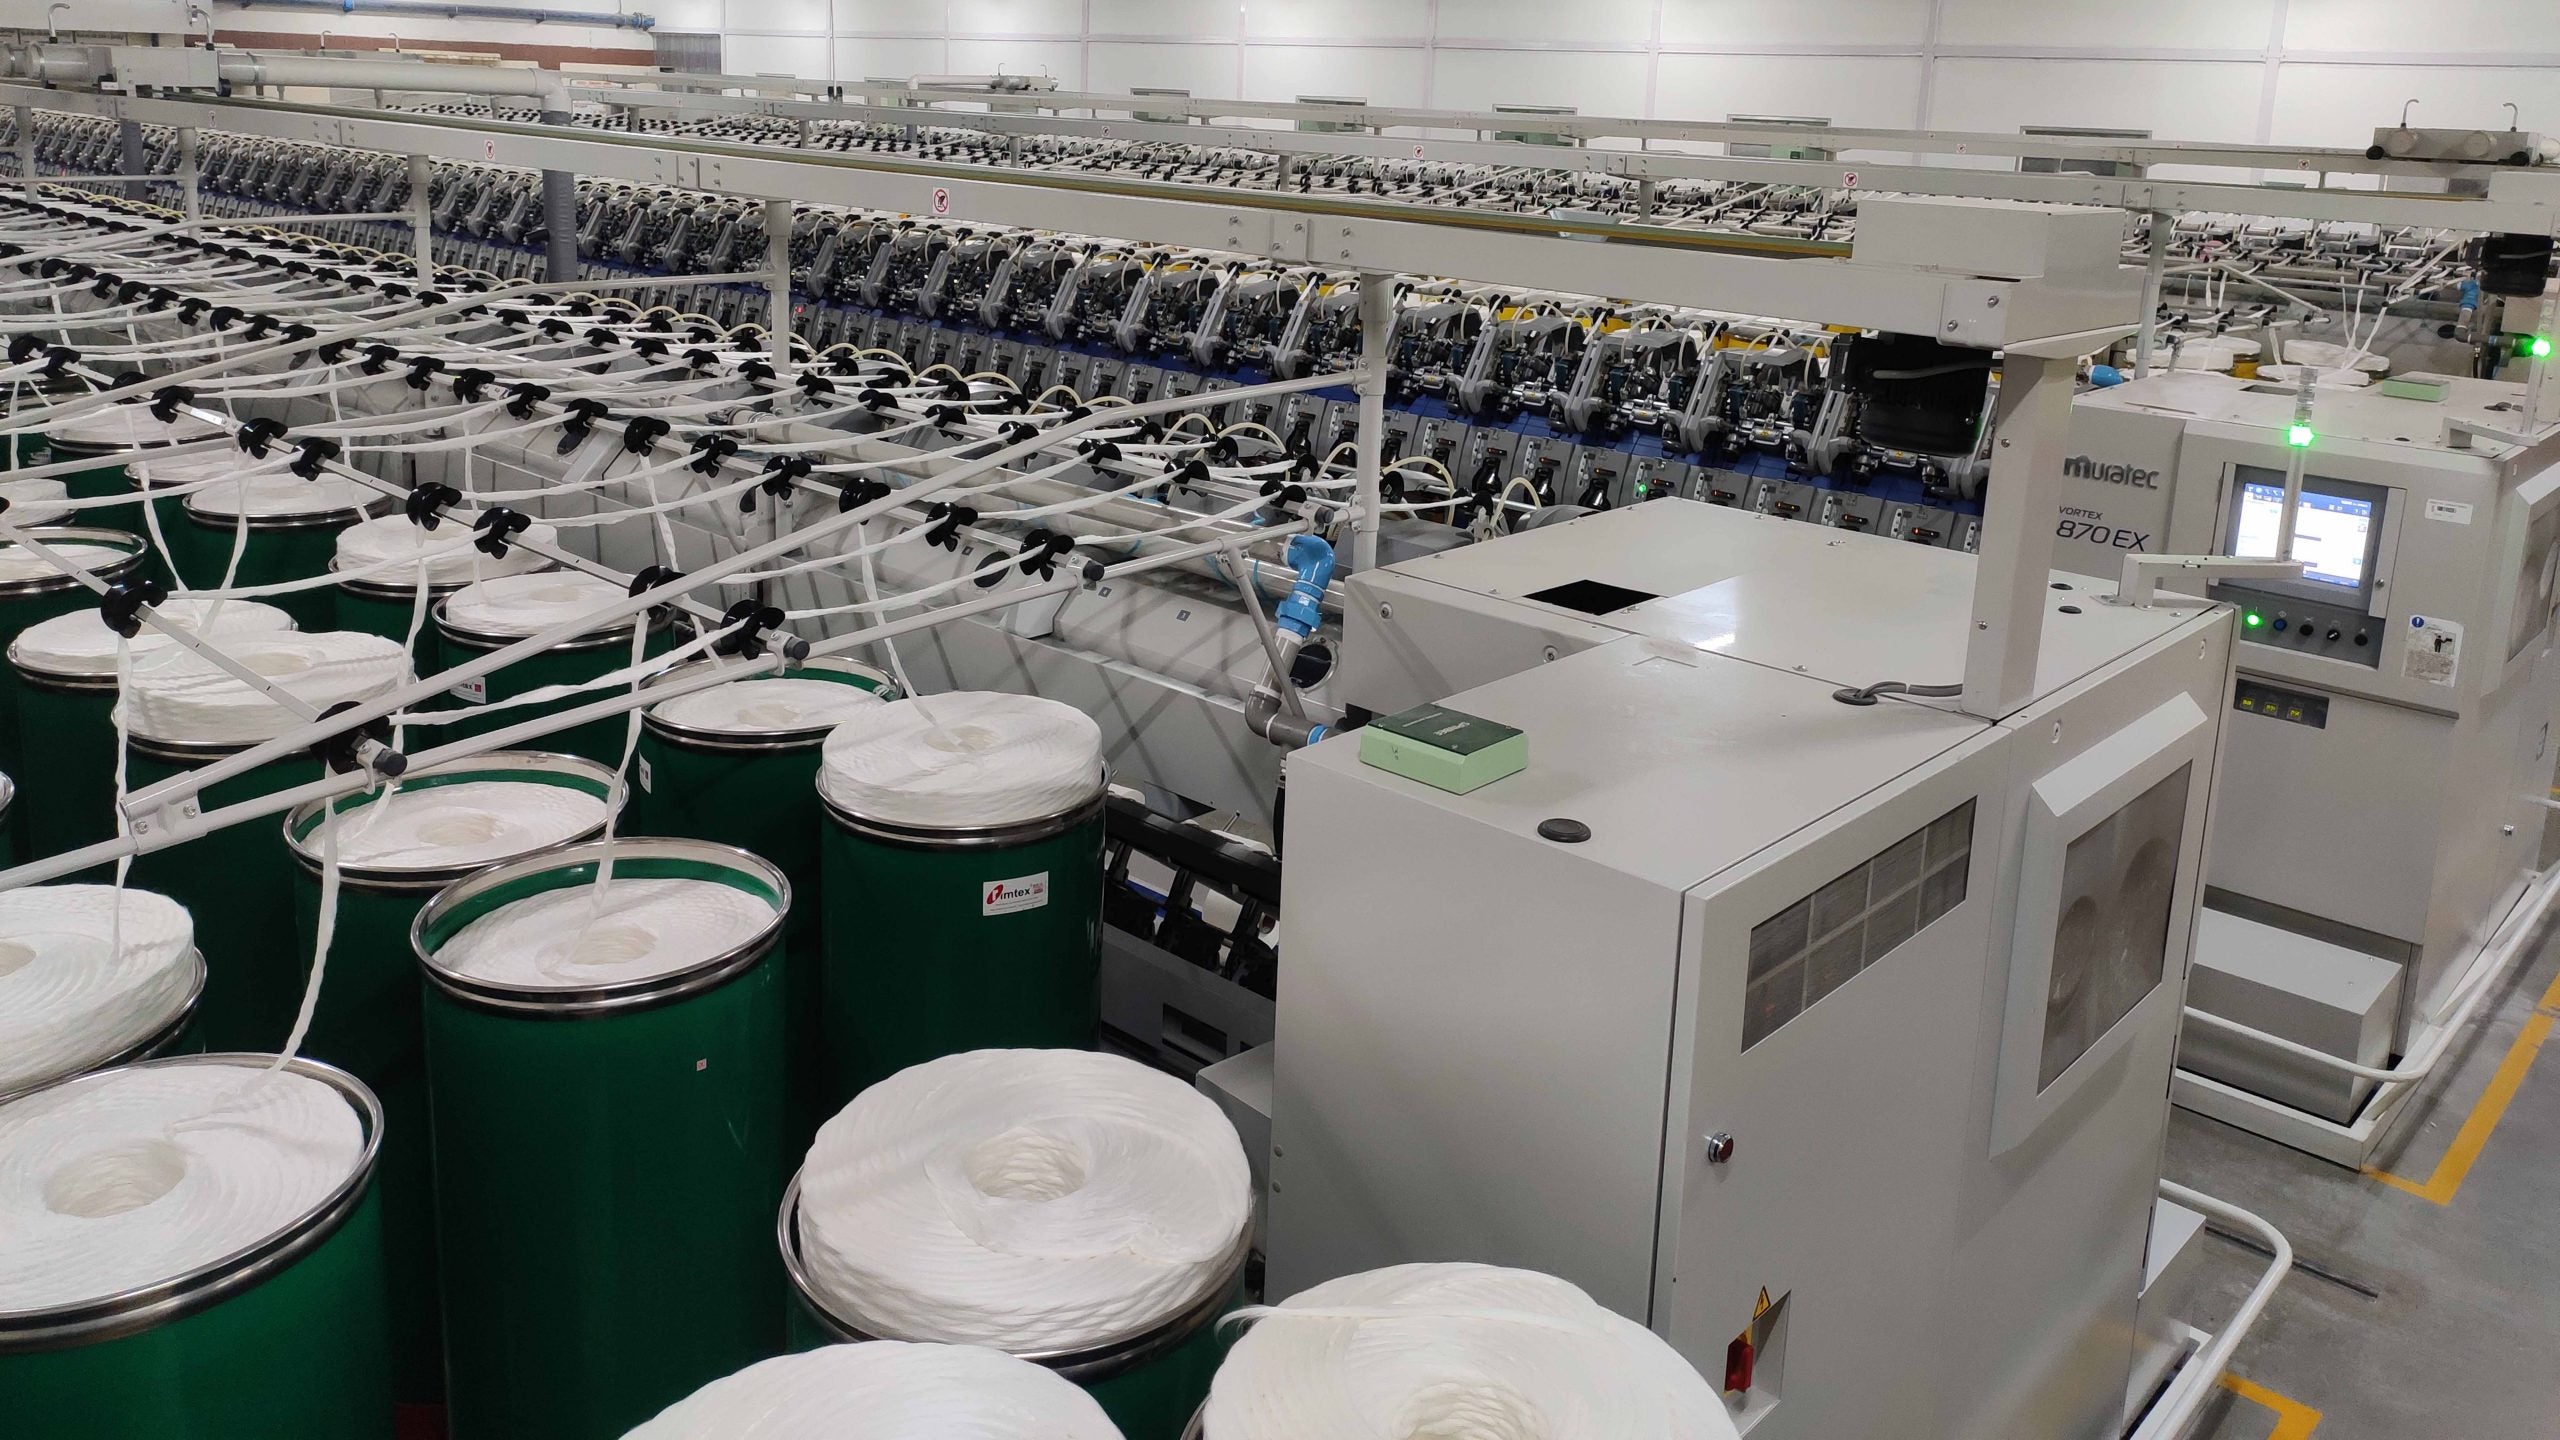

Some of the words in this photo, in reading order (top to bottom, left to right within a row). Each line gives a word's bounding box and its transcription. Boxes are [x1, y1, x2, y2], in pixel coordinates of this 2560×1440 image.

[2063, 455, 2160, 490] muratec
[2059, 506, 2103, 520] VORTEX
[2056, 520, 2111, 544] 870
[2112, 529, 2150, 552] EX
